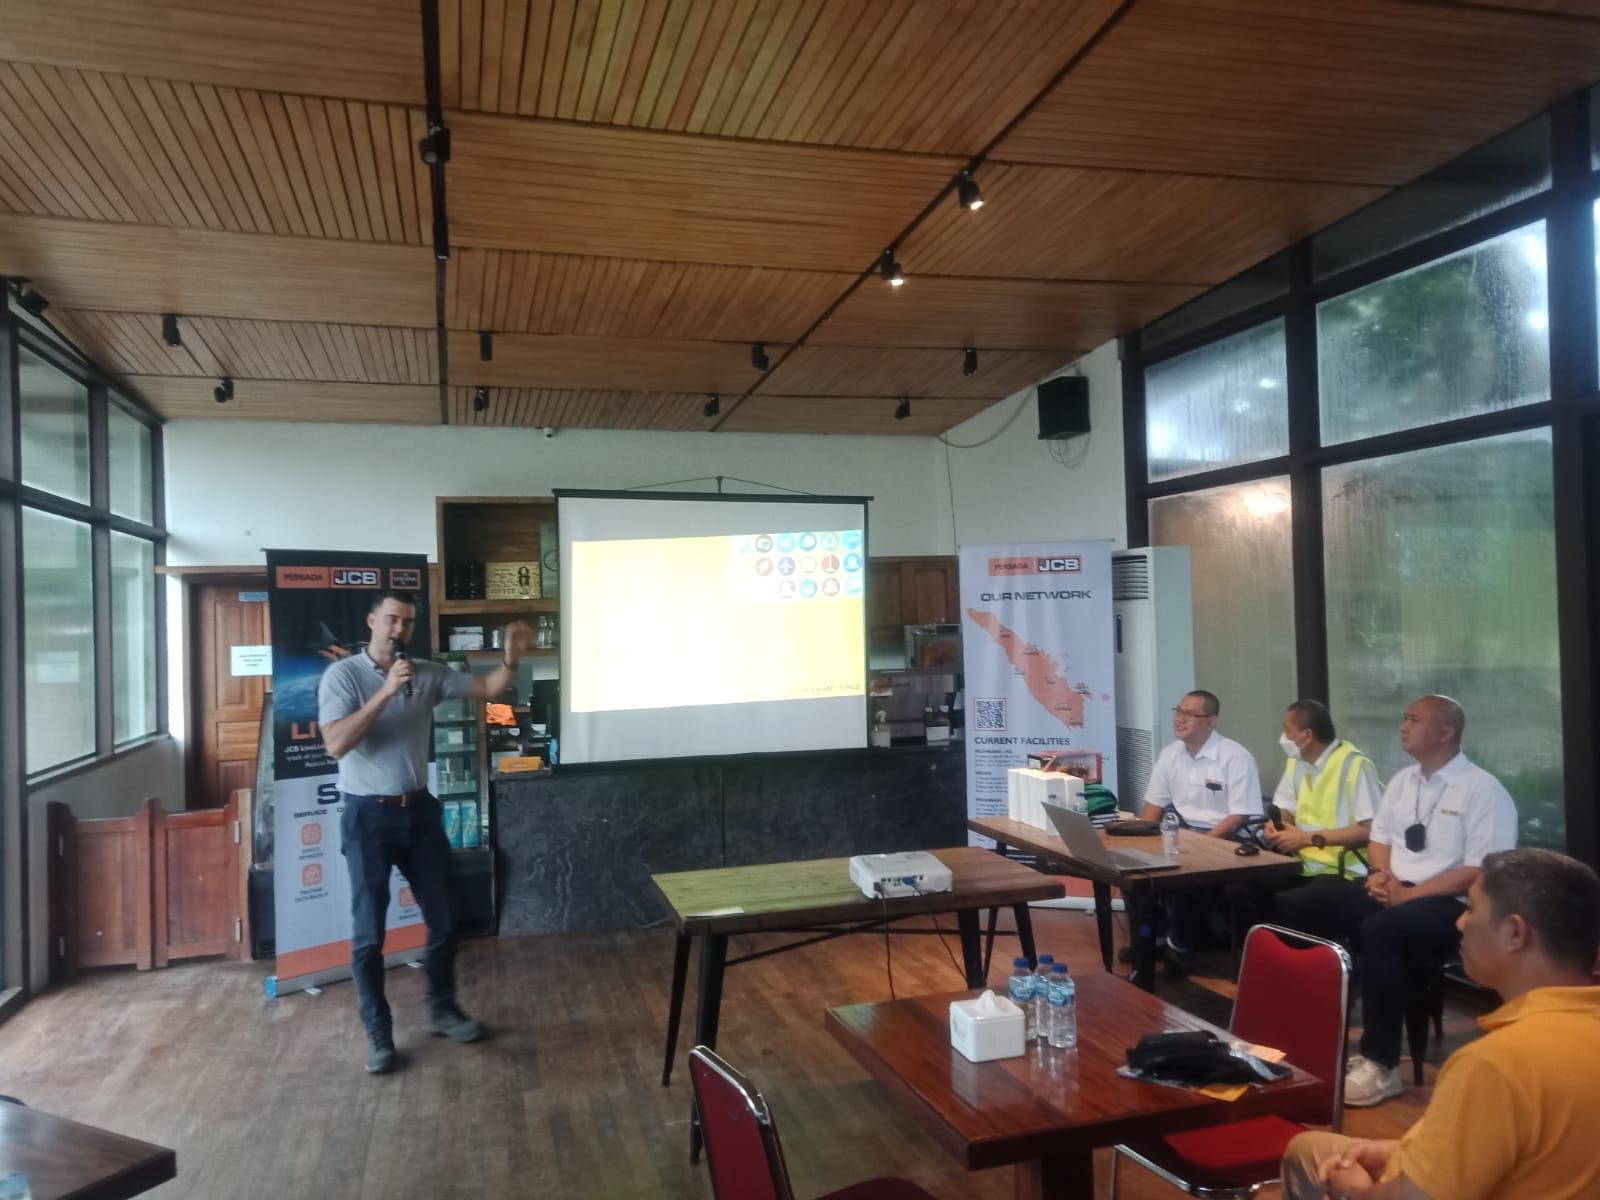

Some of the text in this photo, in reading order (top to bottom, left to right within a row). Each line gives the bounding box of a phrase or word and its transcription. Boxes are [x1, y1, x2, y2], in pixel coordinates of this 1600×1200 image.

[1039, 558, 1079, 571] JCB
[283, 571, 377, 585] PERSADA JCB
[981, 590, 1092, 601] OUR NETWORK
[974, 736, 1071, 746] CURRENT FACILITIES
